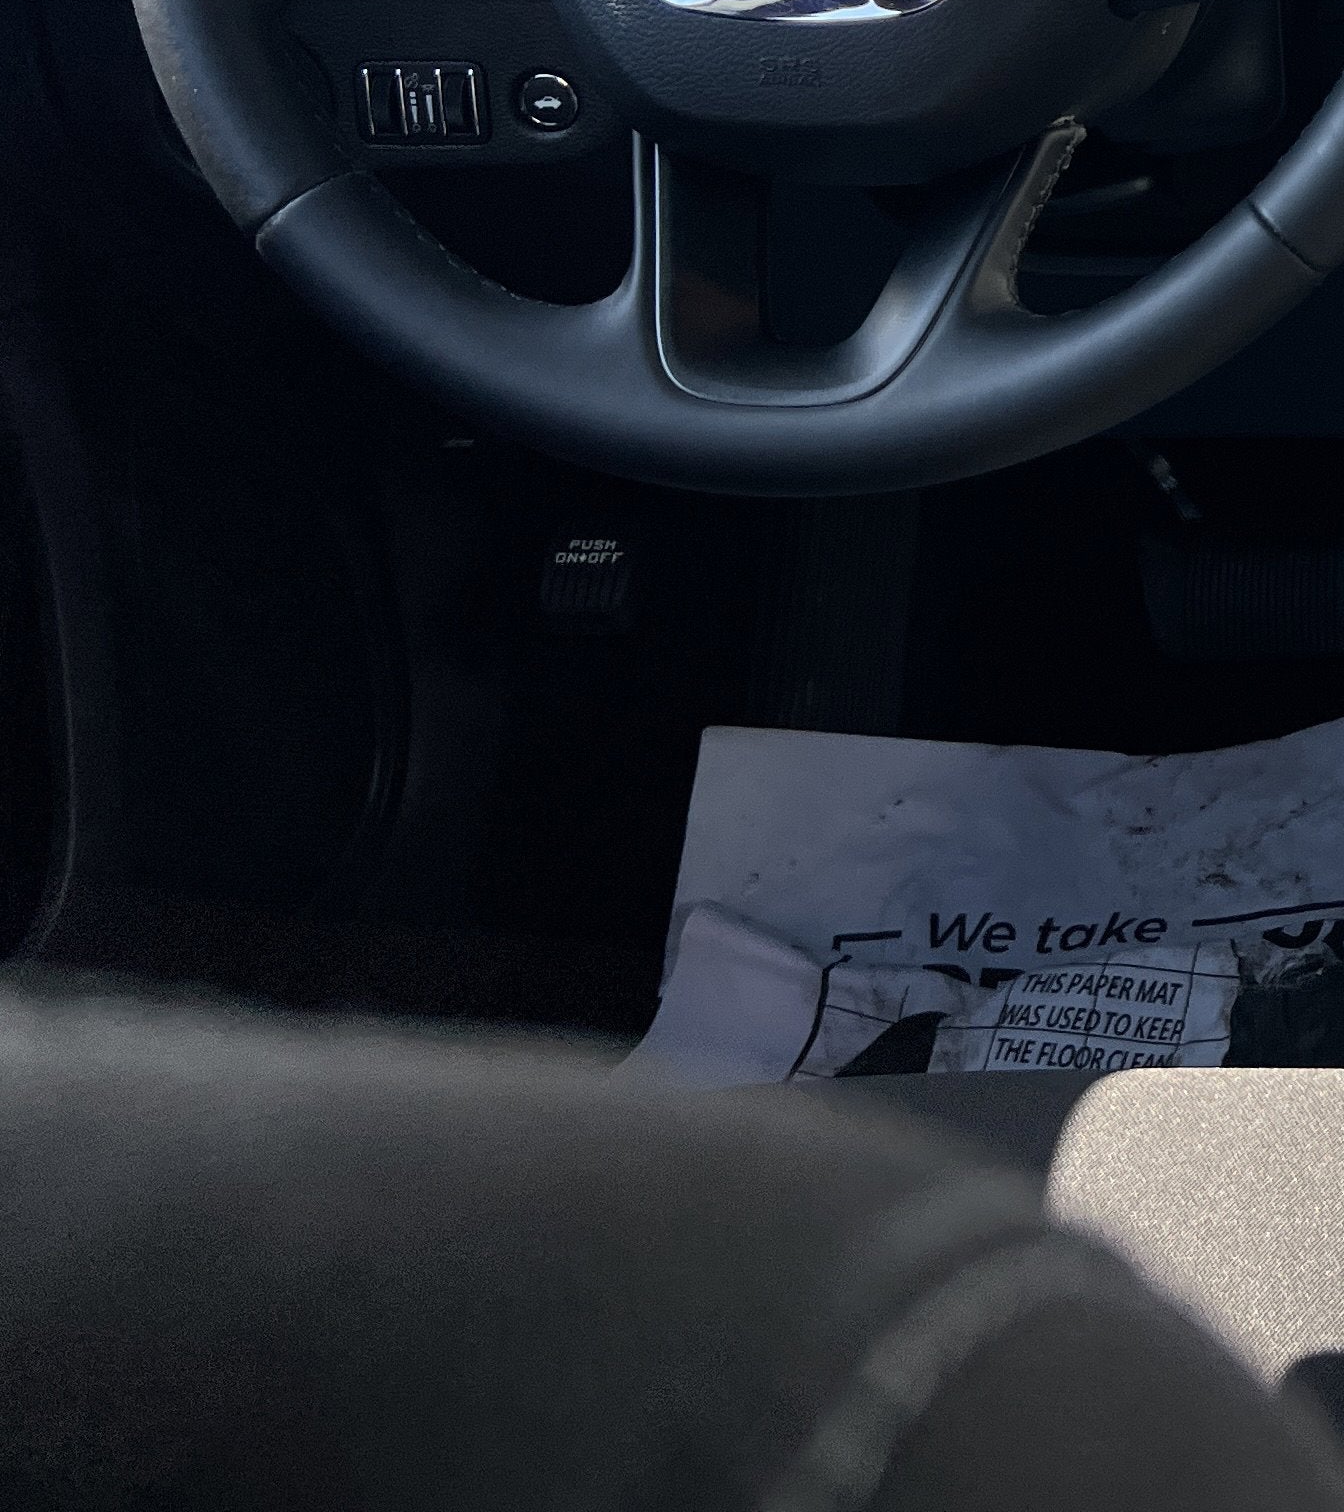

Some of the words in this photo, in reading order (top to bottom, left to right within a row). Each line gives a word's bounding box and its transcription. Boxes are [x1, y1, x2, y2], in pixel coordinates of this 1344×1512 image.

[569, 539, 617, 550] PUSH
[929, 911, 1017, 953] We
[1036, 911, 1168, 954] take
[1022, 973, 1069, 993] THIS
[1066, 973, 1133, 1000] PAPER
[1135, 980, 1184, 1006] MAT
[1001, 1003, 1045, 1027] WAS
[1046, 1005, 1100, 1032] USED
[1103, 1011, 1131, 1036] TO
[1131, 1014, 1186, 1043] KEEP
[996, 1037, 1037, 1064] THE
[1036, 1041, 1107, 1070] FLOOR
